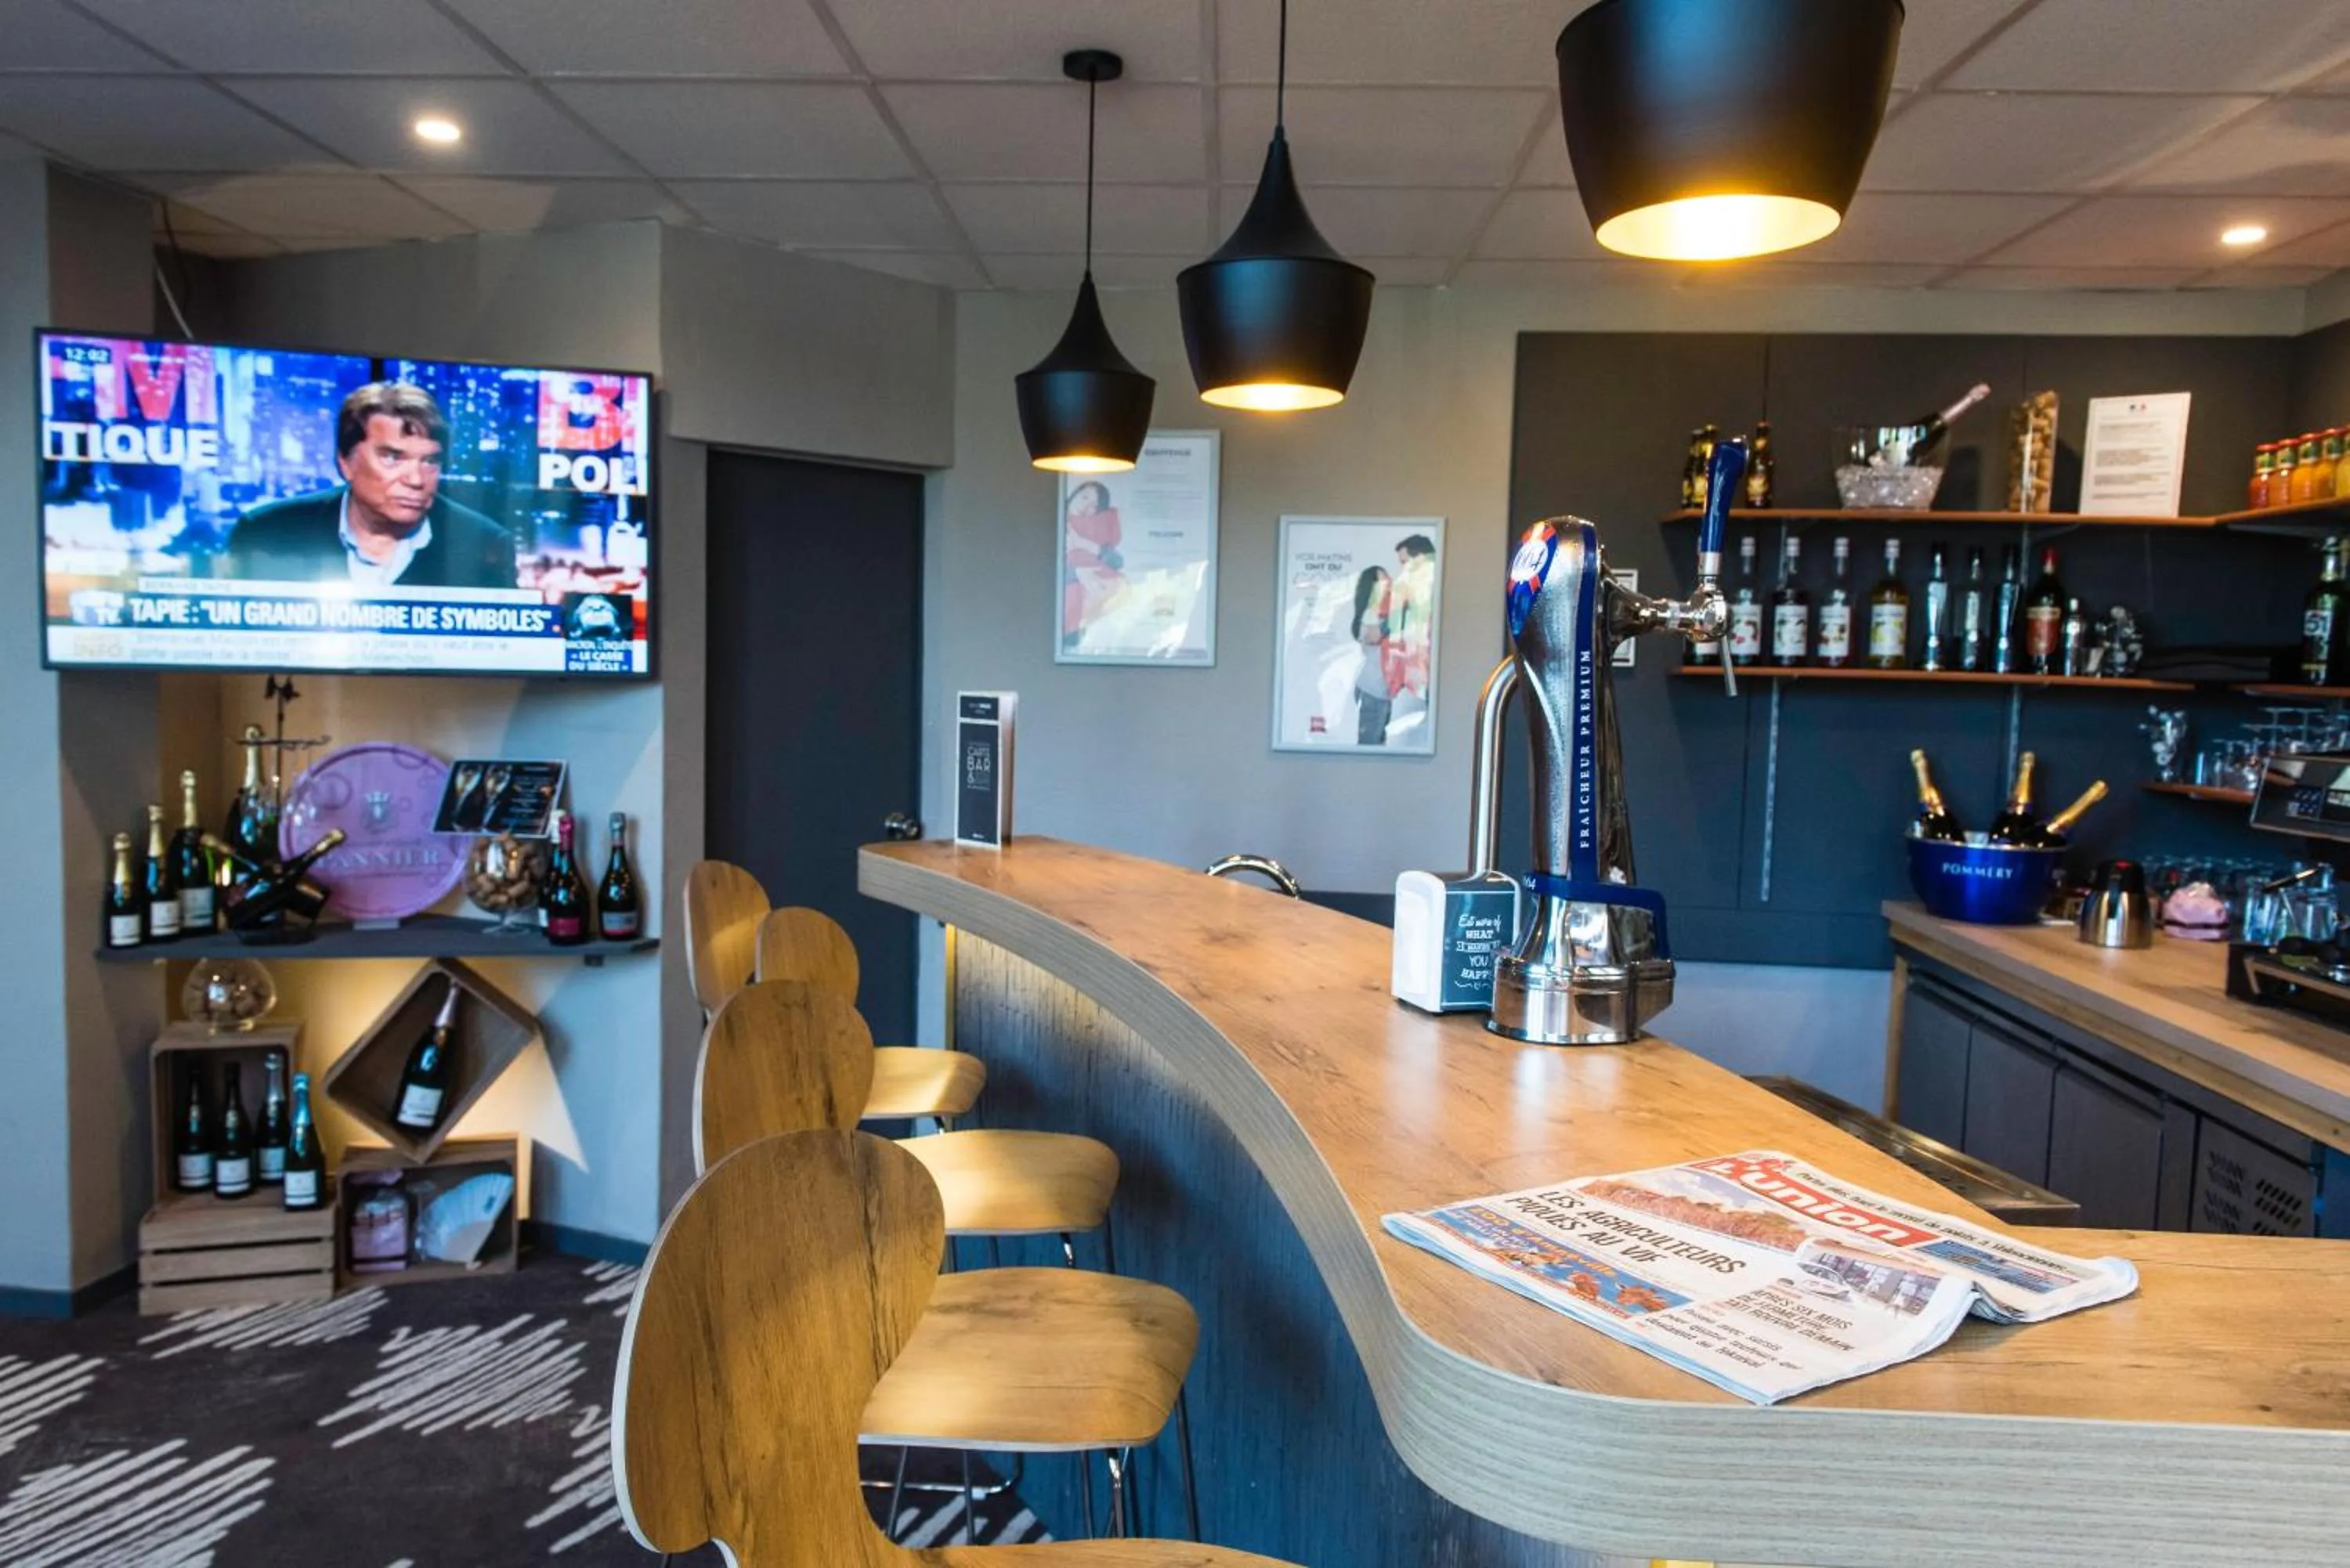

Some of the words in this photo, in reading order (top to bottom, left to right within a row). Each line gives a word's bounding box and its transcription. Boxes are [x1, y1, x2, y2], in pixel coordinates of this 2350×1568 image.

[244, 601, 317, 626] GRAND
[320, 602, 409, 630] NOMBRE
[411, 607, 439, 630] DE
[1579, 650, 1592, 736] PREMIUM
[967, 756, 991, 773] BAR
[1942, 862, 2013, 879] POMMERY
[1466, 930, 1495, 940] WHAT
[1469, 956, 1488, 968] YOU
[1506, 1196, 1589, 1231] PIQUÉS
[1578, 1230, 1625, 1247] AU
[1618, 1245, 1670, 1263] VIF
[1536, 1190, 1586, 1210] LES
[1578, 1209, 1748, 1275] AGRICULTEURS
